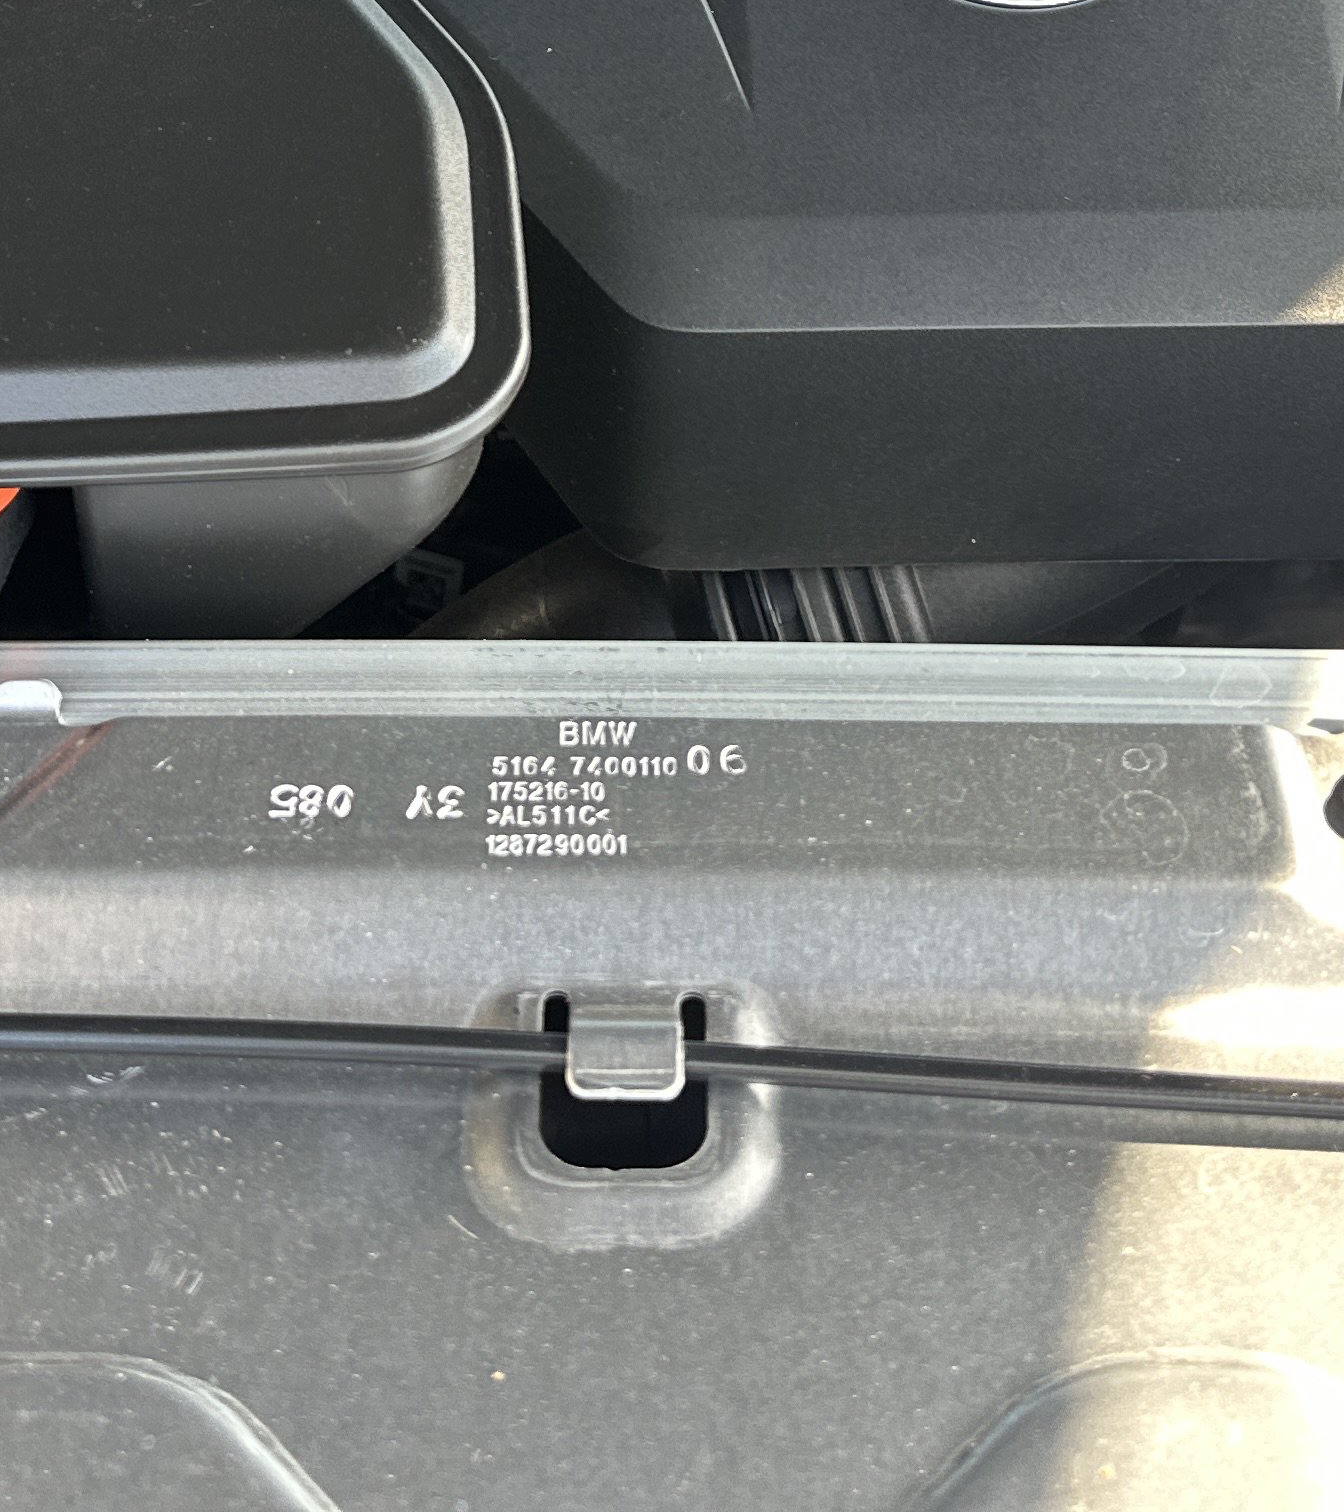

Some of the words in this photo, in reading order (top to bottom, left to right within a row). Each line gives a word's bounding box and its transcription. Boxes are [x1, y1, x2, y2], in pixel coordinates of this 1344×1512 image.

[559, 720, 637, 746] BMW
[492, 755, 557, 776] 5164
[570, 756, 678, 777] 7400110
[488, 781, 606, 802] 175216-10
